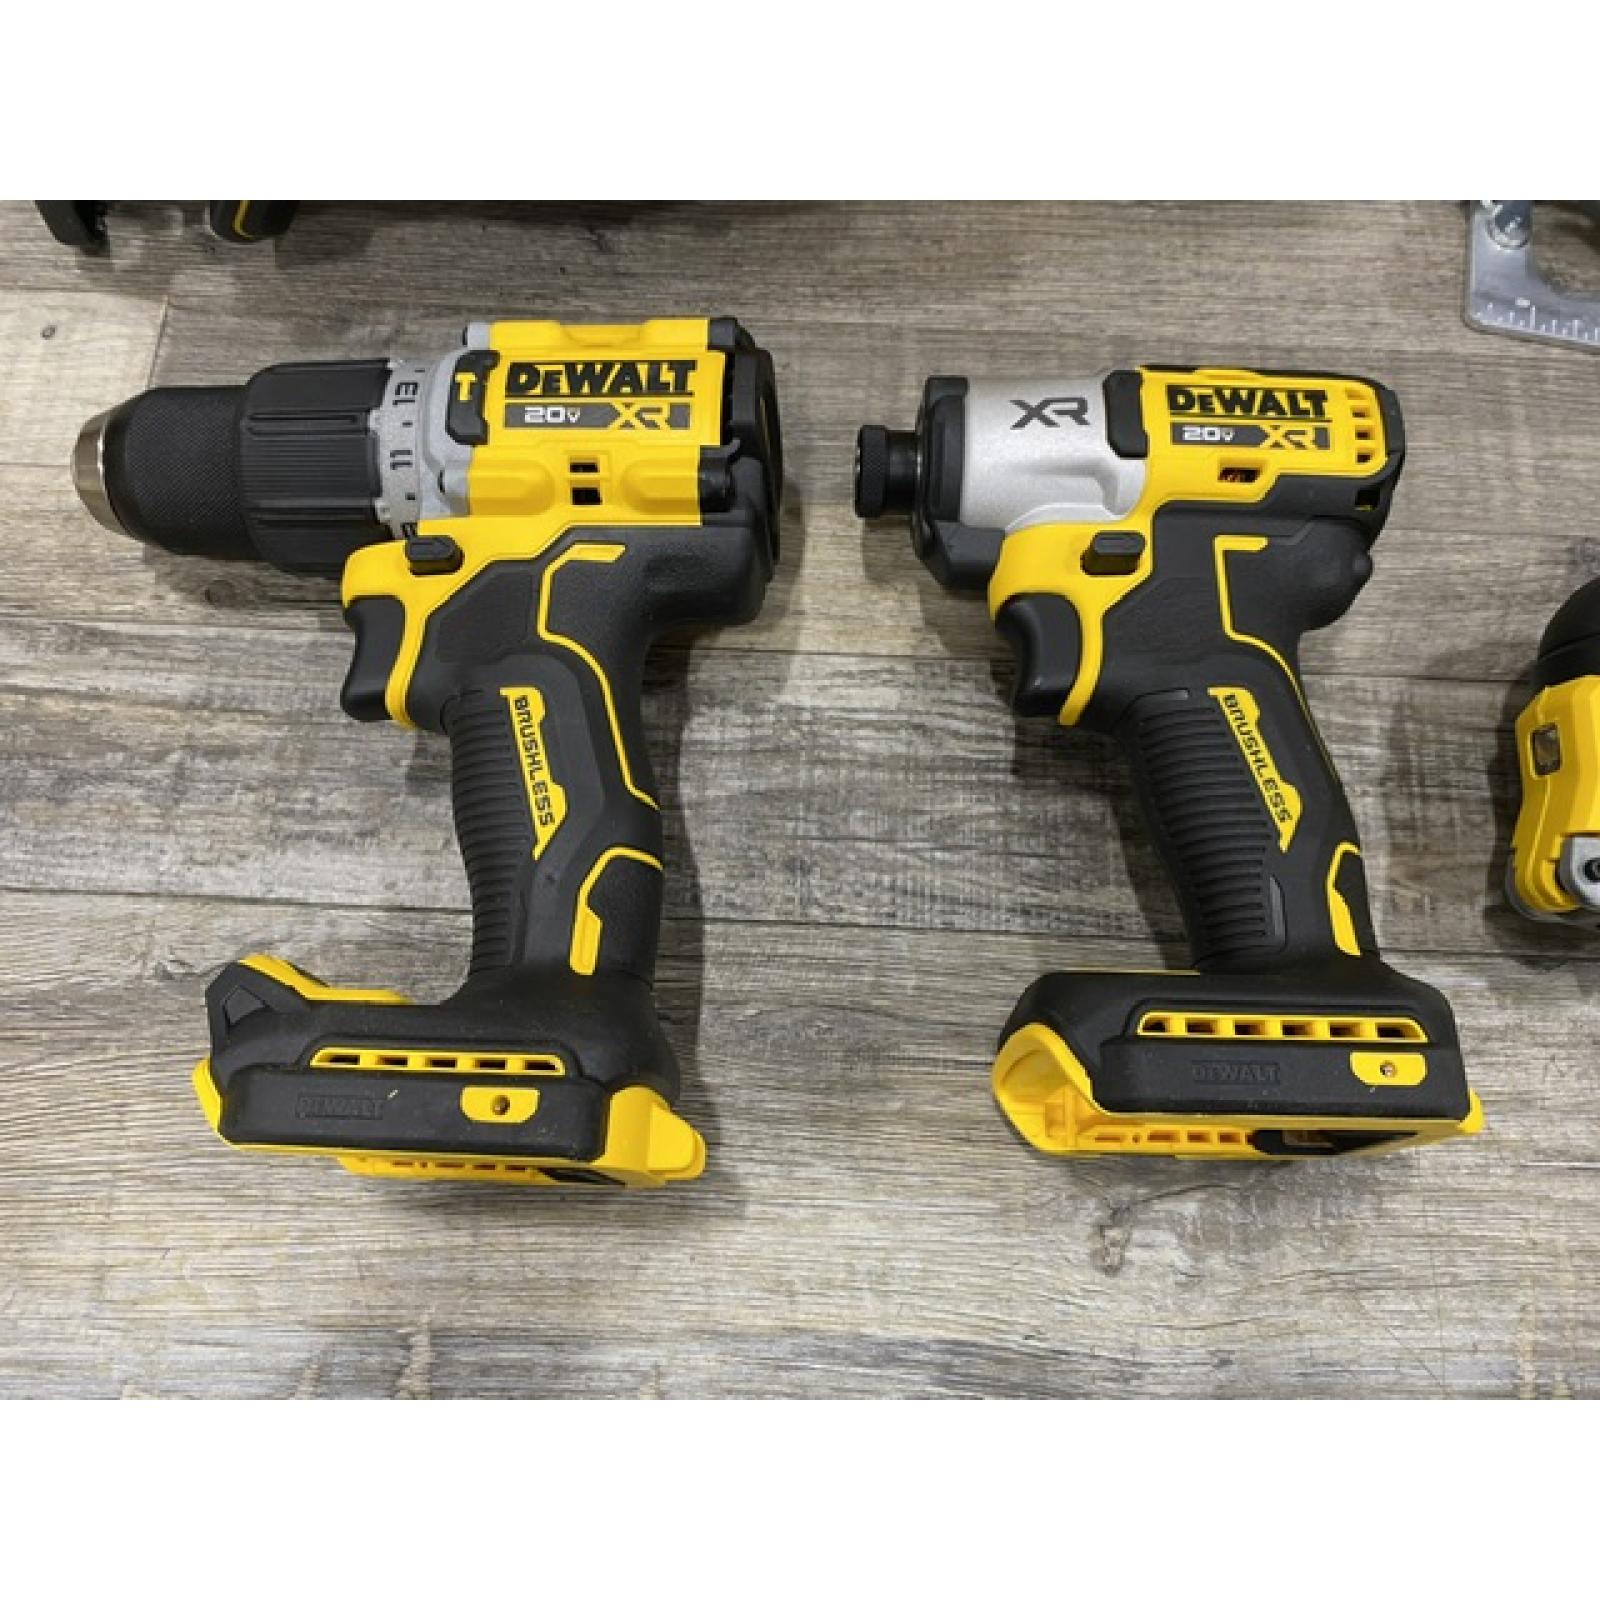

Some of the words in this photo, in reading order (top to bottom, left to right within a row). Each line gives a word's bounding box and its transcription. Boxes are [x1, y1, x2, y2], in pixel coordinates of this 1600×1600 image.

[393, 382, 418, 406] 13
[607, 402, 670, 430] XR
[1009, 396, 1090, 430] XR
[1260, 423, 1317, 450] XR
[390, 450, 413, 471] 11
[514, 694, 555, 826] BRUSHLESS
[1224, 694, 1293, 823] BRUSHLESS
